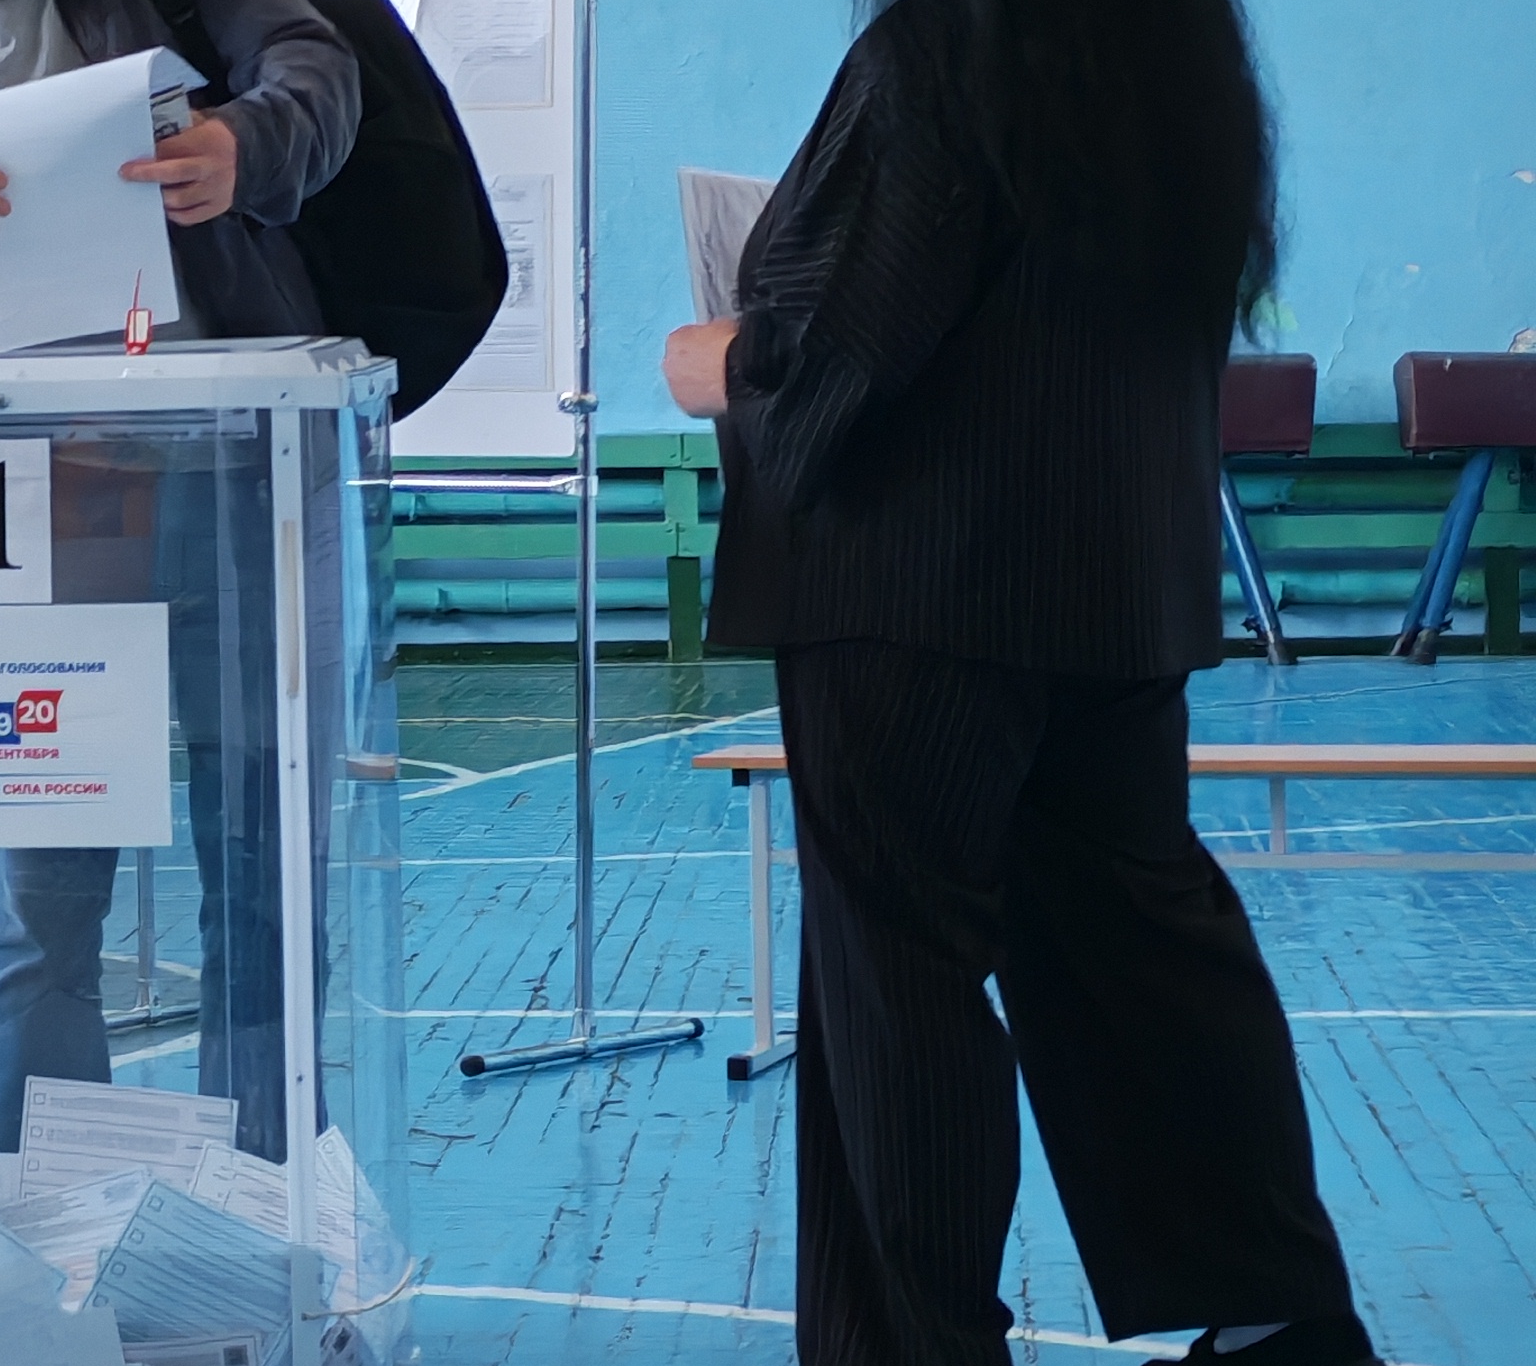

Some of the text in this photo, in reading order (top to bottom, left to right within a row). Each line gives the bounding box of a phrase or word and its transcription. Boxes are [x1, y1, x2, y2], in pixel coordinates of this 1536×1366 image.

[0, 661, 106, 674] ГОЛОСОВАНИЯ
[18, 700, 55, 724] 20
[2, 784, 41, 795] СИЛА
